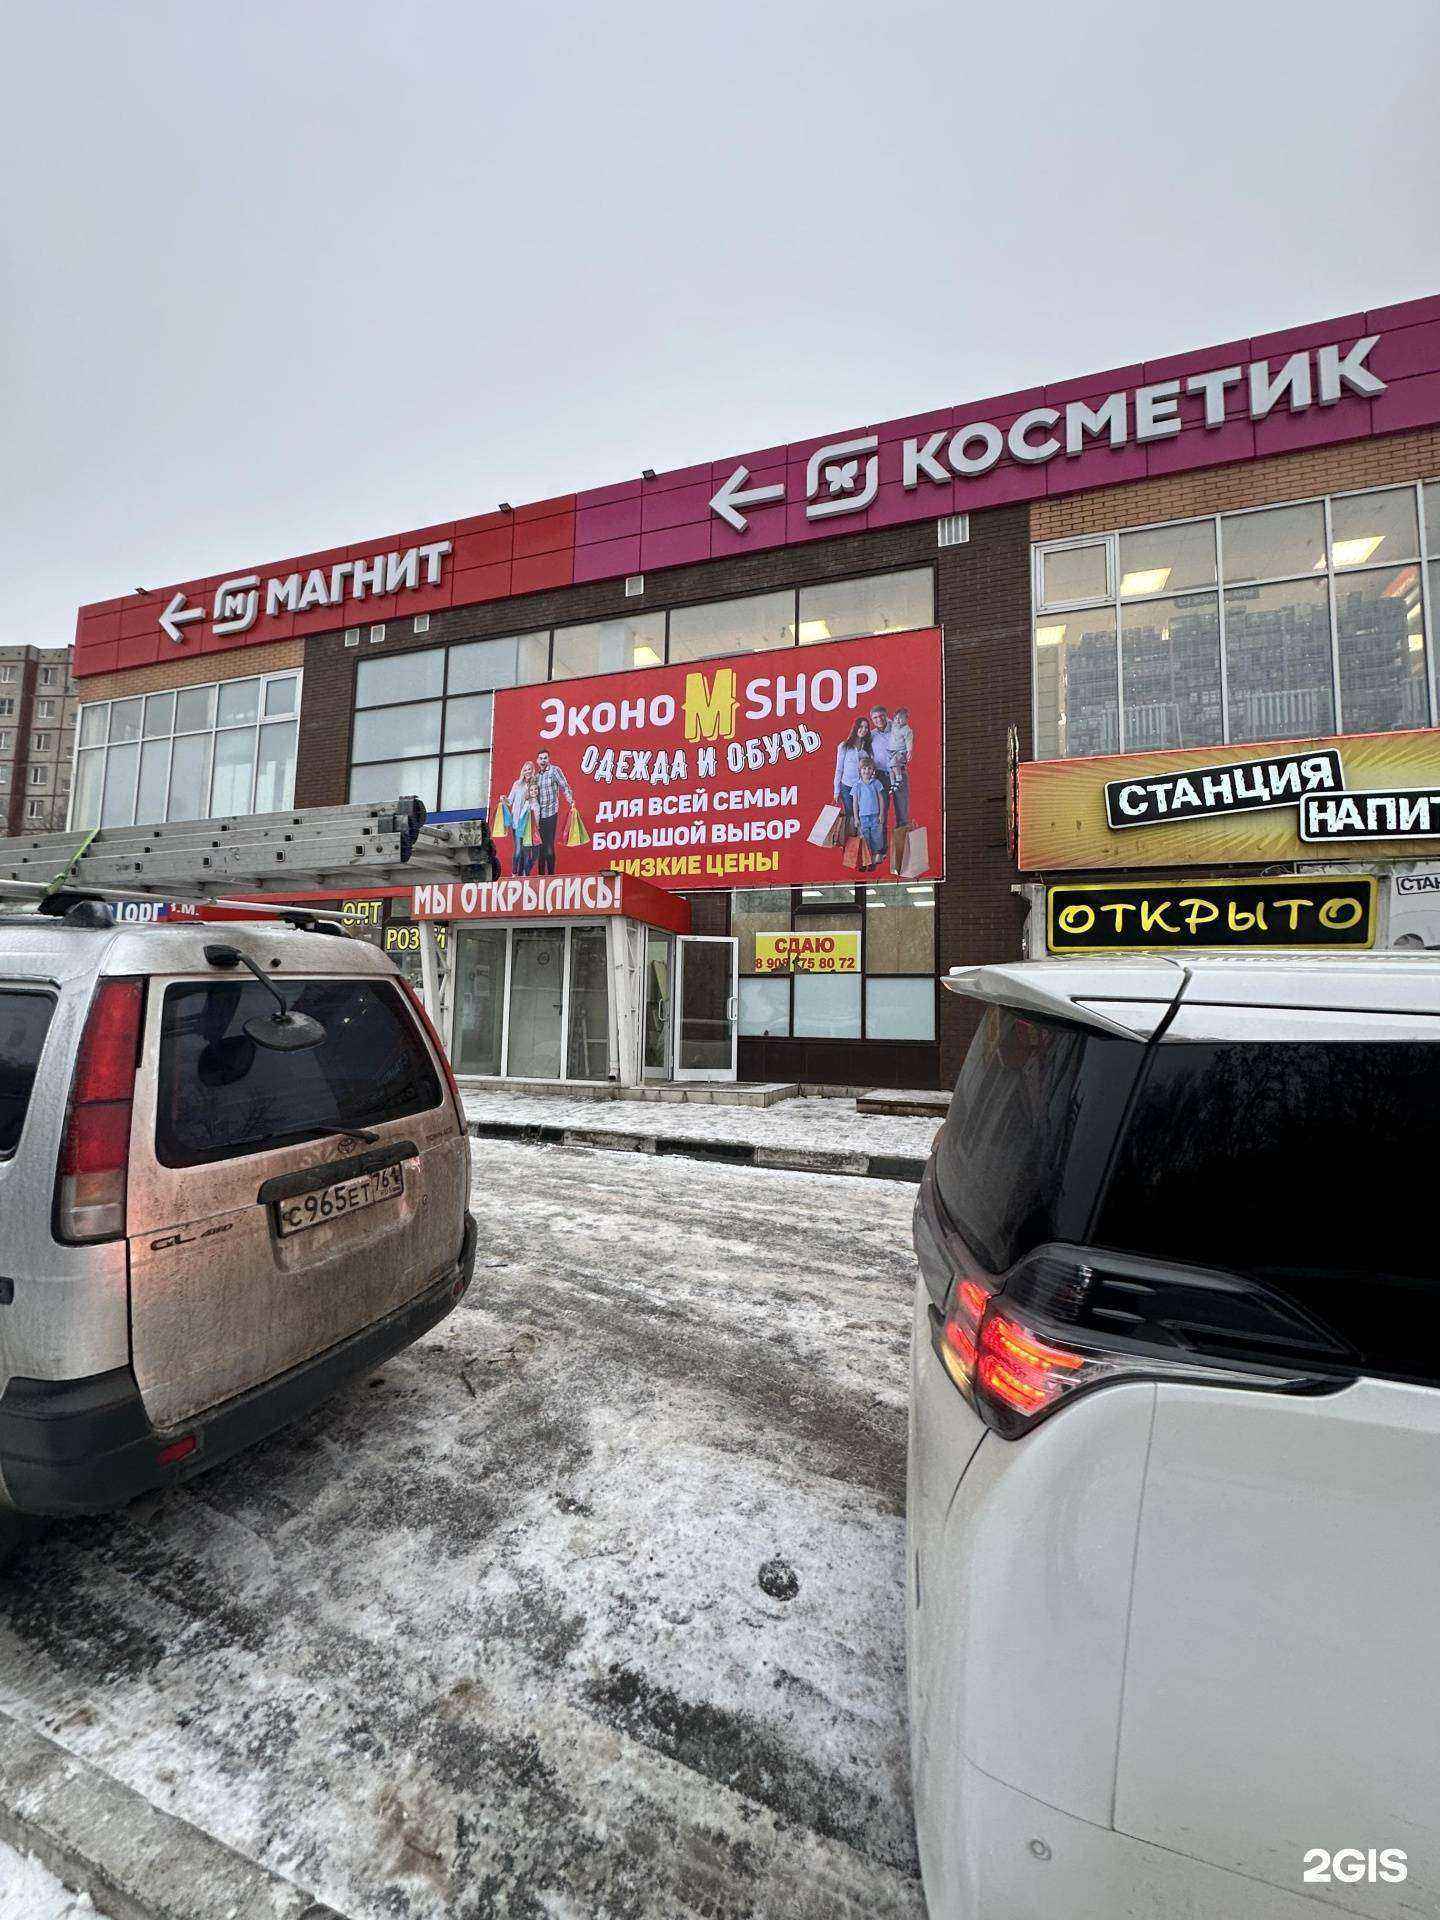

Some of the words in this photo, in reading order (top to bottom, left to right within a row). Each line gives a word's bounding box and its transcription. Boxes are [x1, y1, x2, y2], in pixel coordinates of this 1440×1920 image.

[902, 334, 1389, 490] КОСМЕТИК
[266, 540, 453, 617] МАГНИТ
[745, 665, 878, 720] SHOP
[580, 745, 687, 786] ОДЕЖДА
[697, 746, 717, 778] И
[727, 723, 822, 772] ОБУВЬ
[595, 799, 644, 824] ДЛЯ
[648, 788, 708, 816] ВСЕЙ
[713, 786, 798, 811] СЕМЬИ
[1118, 756, 1335, 816] СТАНЦИЯ
[592, 820, 706, 851] БОЛЬШОЙ
[711, 819, 801, 842] ВЫБОР
[706, 851, 779, 878] ЦЕНЫ
[342, 901, 383, 926] ОПТ
[414, 884, 453, 915] МЫ
[460, 875, 621, 914] ОТКРЫЛИСЬ!
[1058, 897, 1363, 935] ОТКРЫТО
[774, 937, 835, 954] СДАЮ
[818, 957, 835, 969] 80
[838, 957, 856, 969] 72
